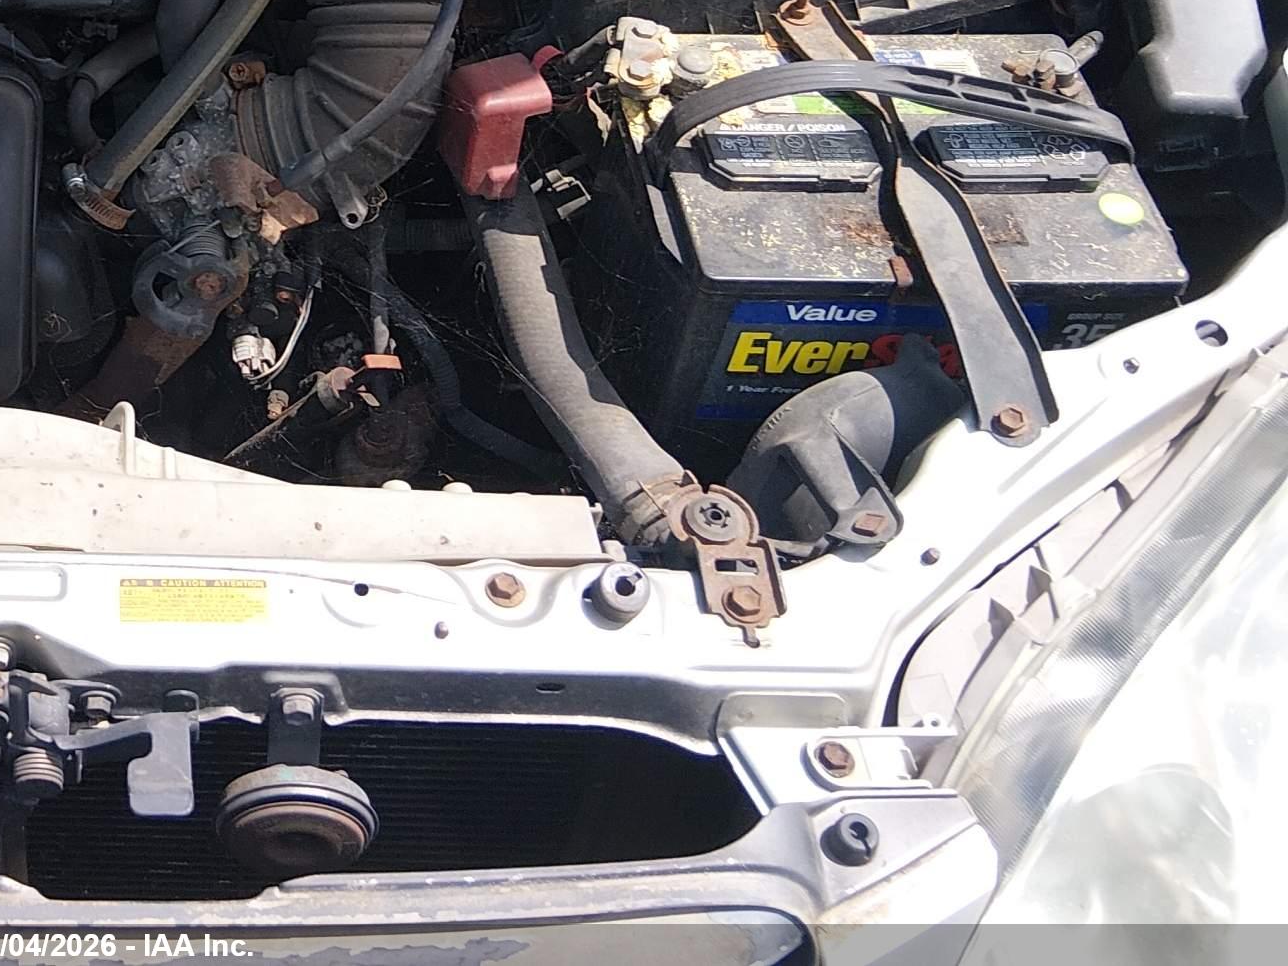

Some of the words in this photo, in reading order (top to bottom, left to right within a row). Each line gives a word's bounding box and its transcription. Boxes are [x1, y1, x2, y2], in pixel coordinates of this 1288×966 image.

[798, 124, 846, 132] POISON
[786, 304, 878, 323] Value
[214, 580, 264, 588] ATTENTION
